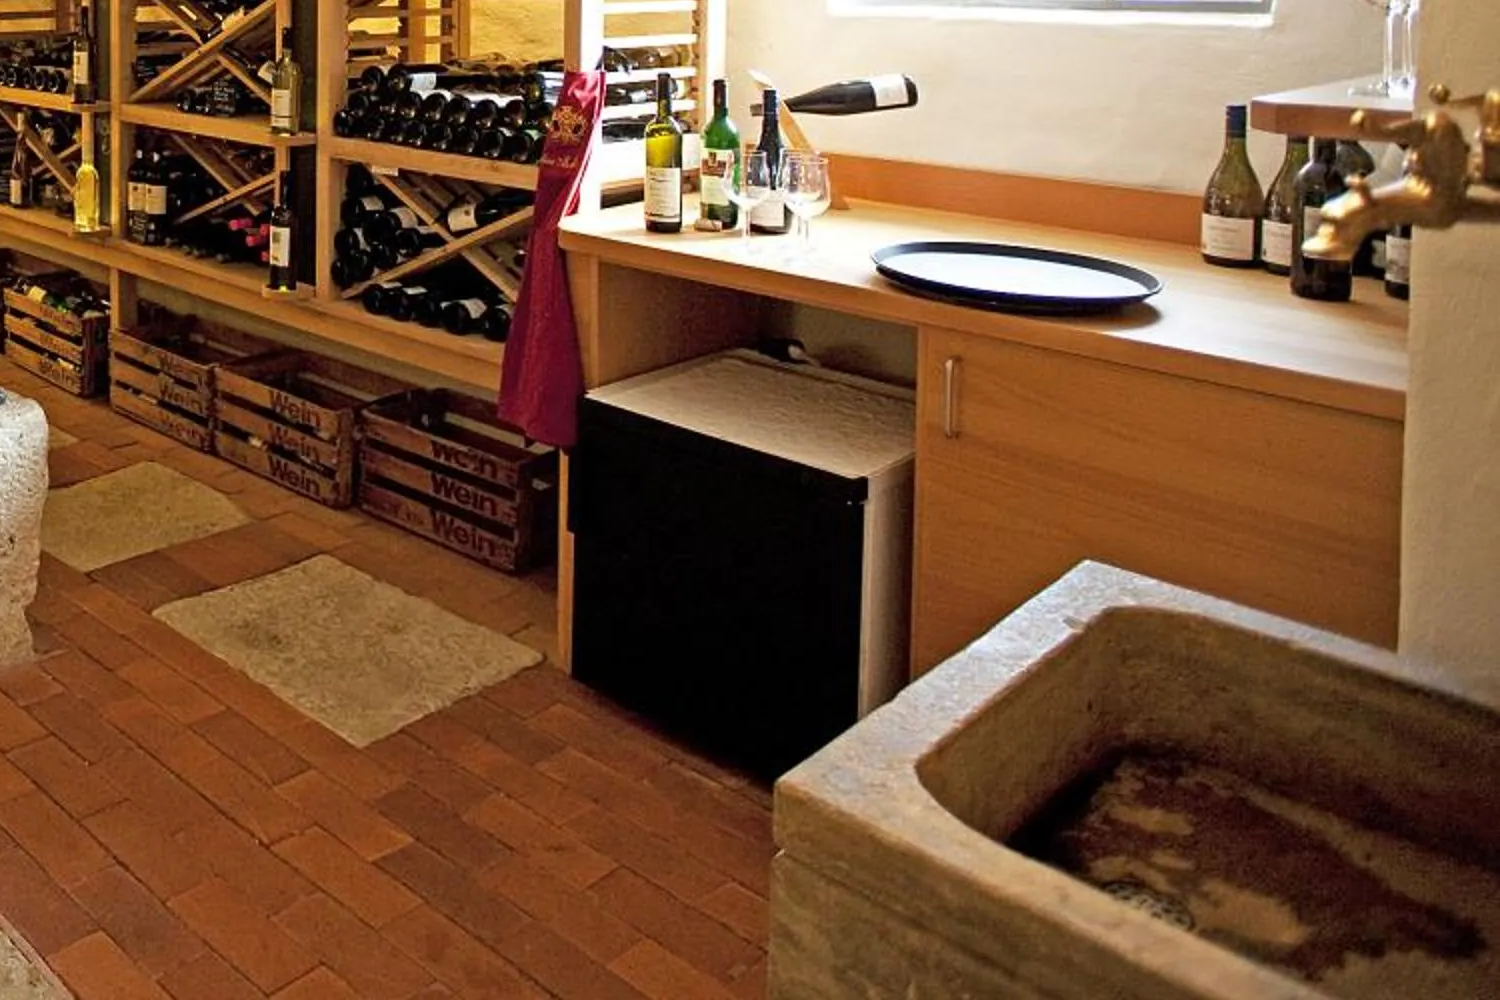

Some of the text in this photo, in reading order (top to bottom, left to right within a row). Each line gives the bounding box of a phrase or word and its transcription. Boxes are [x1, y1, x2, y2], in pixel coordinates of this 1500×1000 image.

[269, 391, 321, 427] Wein
[267, 424, 319, 464] Wein
[268, 455, 321, 493] Wein
[431, 471, 498, 516] Wein
[432, 507, 498, 557] Wein
